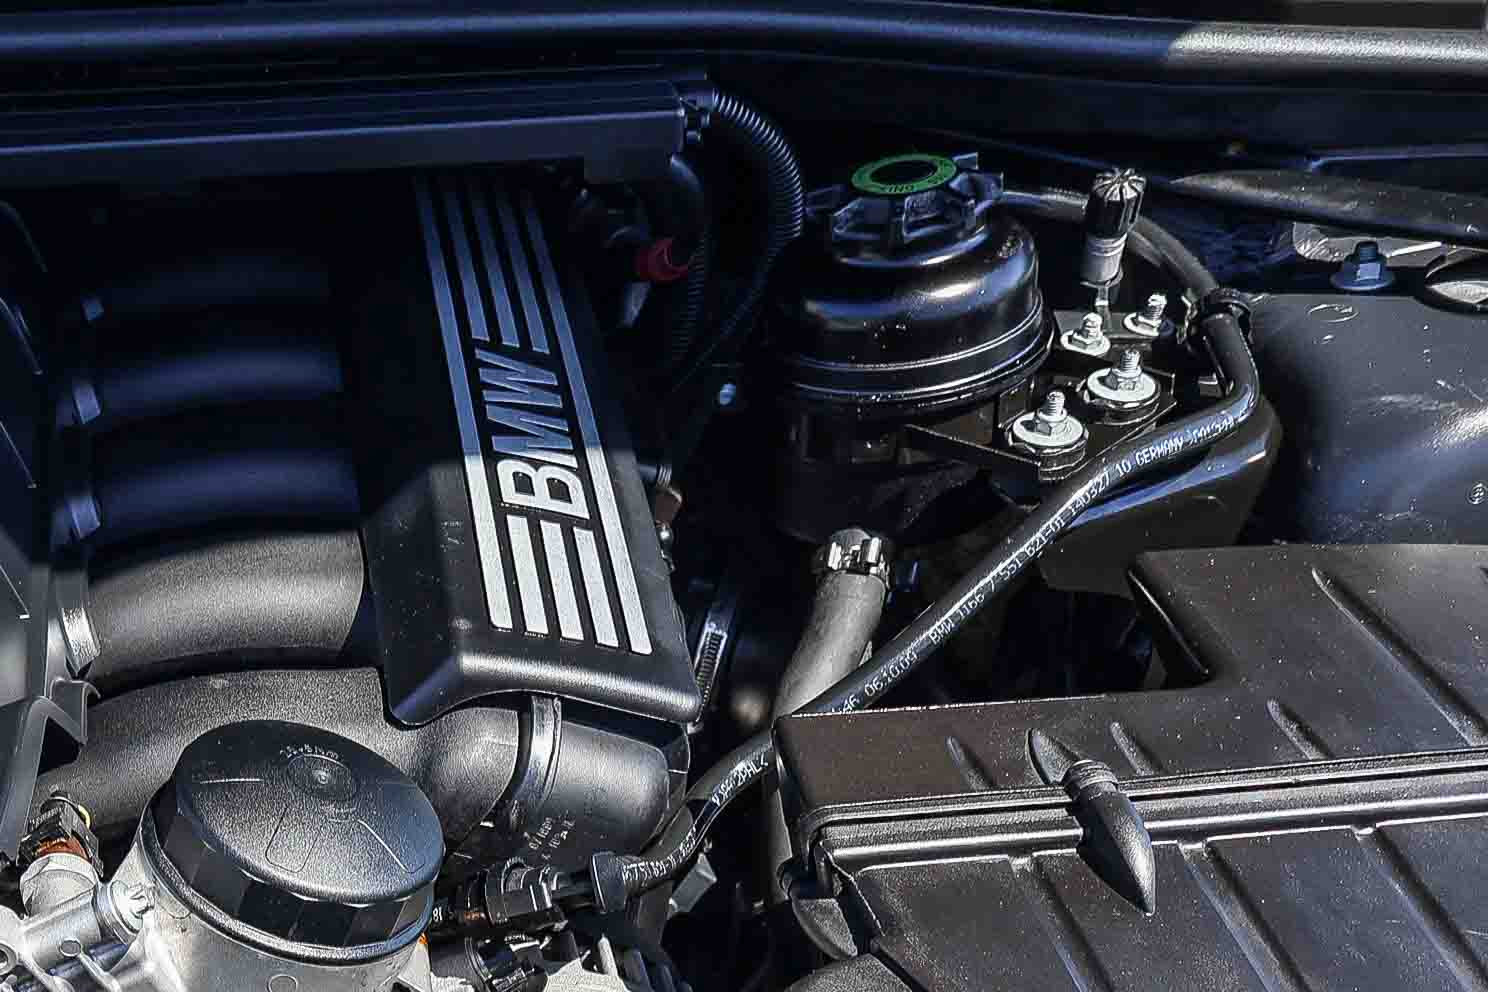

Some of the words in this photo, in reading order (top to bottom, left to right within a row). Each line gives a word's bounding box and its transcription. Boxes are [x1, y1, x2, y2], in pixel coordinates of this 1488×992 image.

[474, 347, 591, 519] BMW
[929, 619, 956, 645] BMW
[1135, 436, 1184, 466] GERMANY
